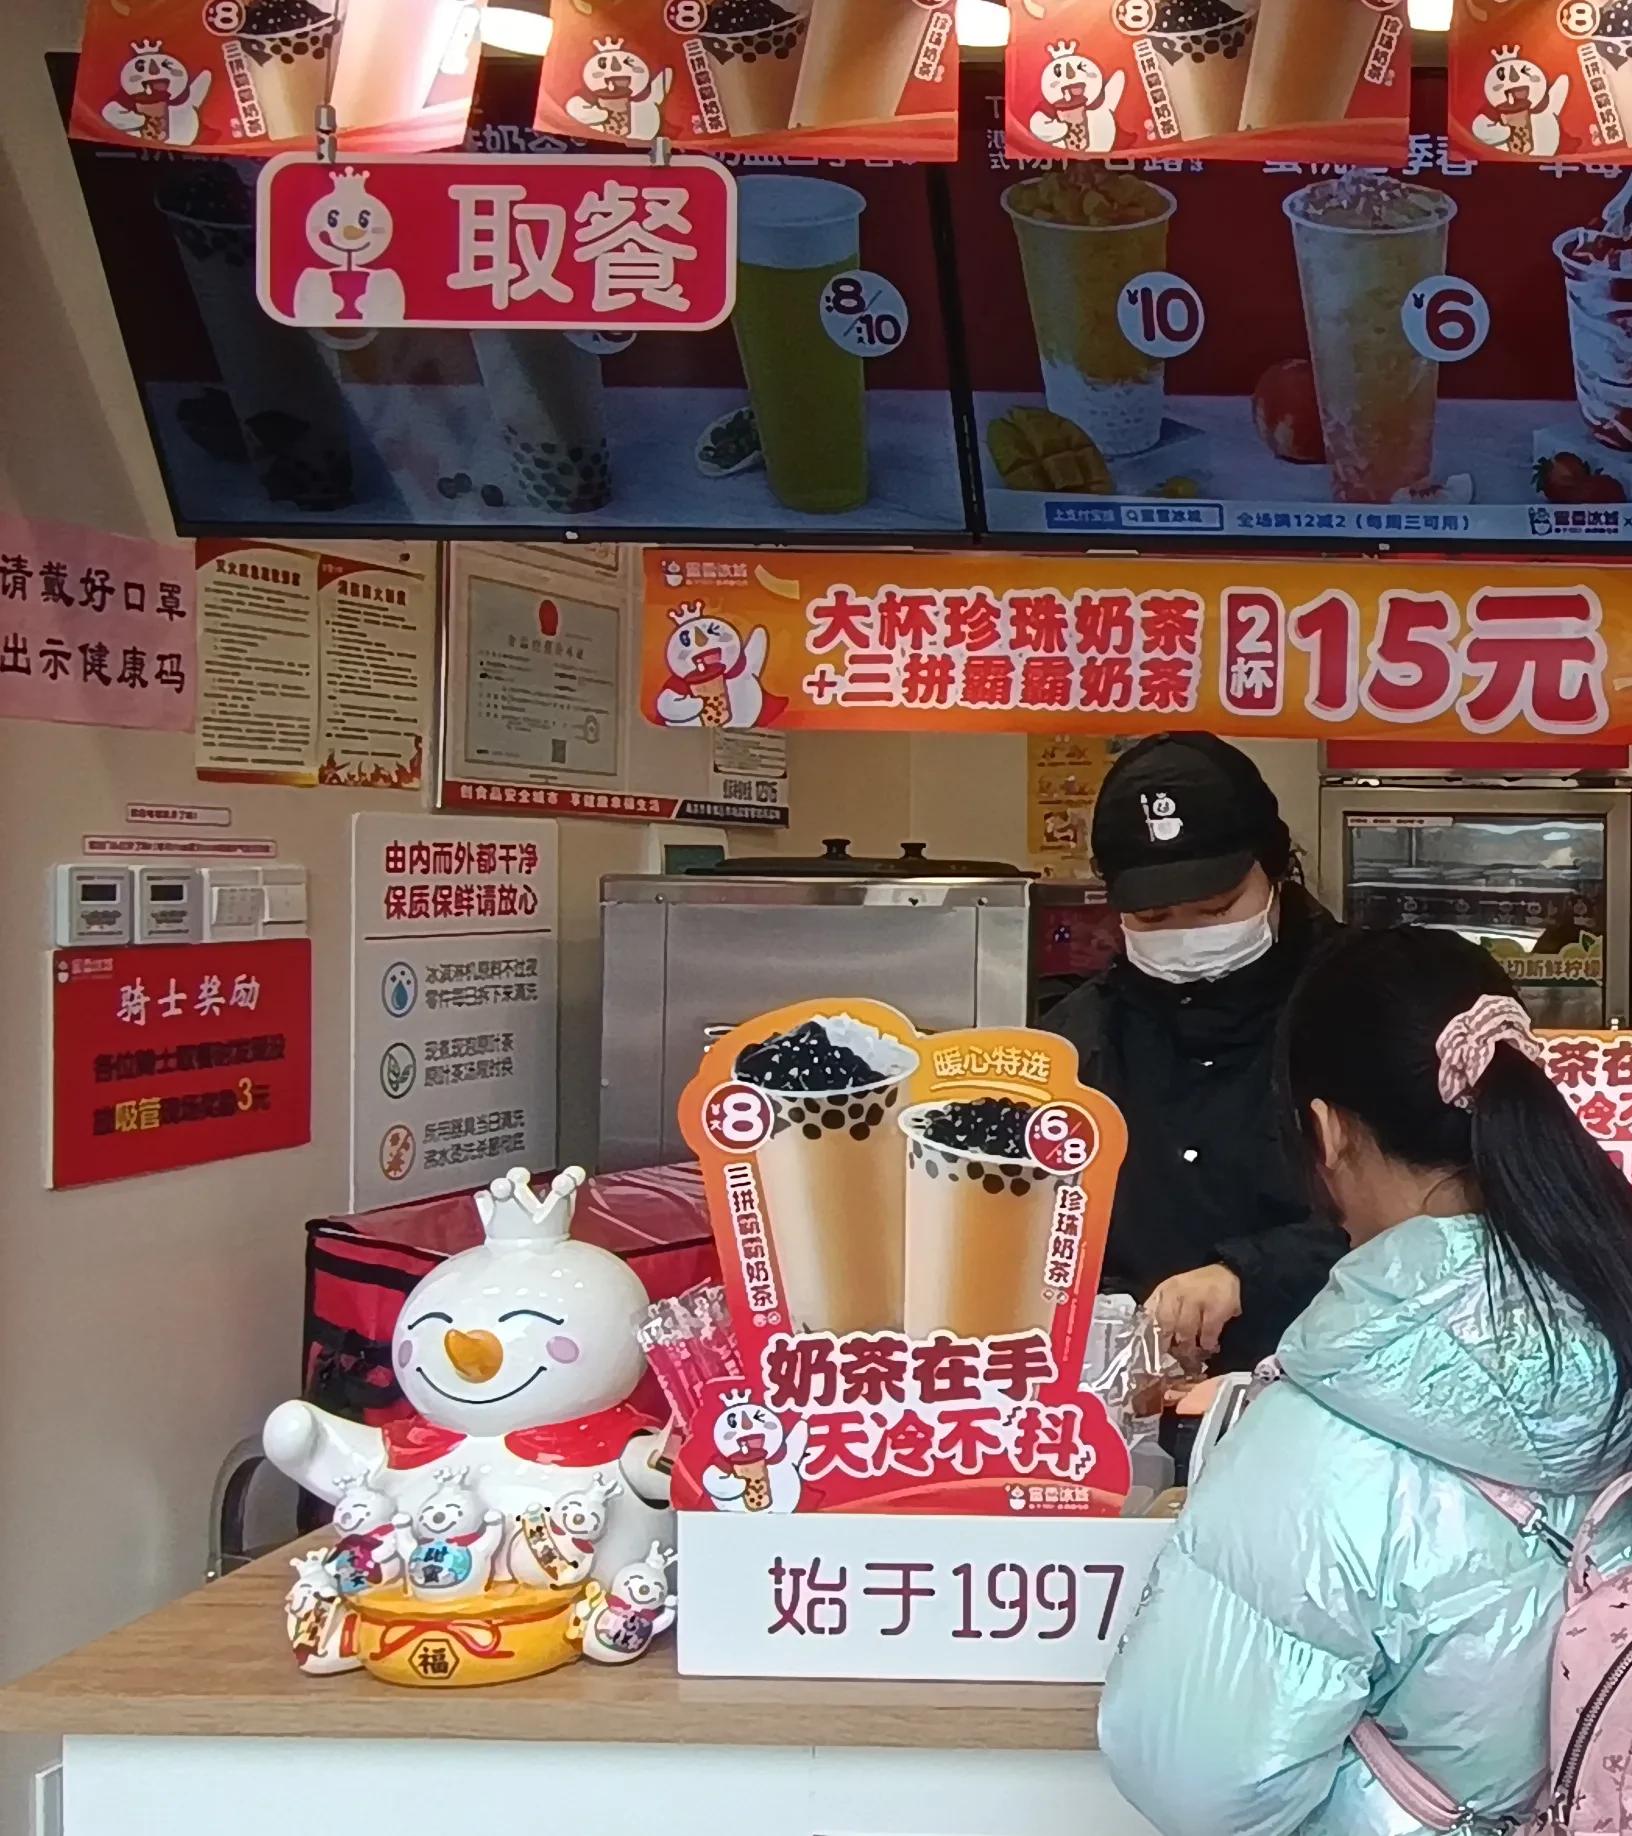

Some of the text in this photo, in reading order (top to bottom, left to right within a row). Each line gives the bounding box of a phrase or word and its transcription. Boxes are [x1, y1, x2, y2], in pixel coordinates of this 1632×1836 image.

[448, 181, 698, 312] 取餐
[0, 553, 188, 622] 请戴好口罩
[811, 589, 1199, 656] 大杯珍珠奶茶
[0, 632, 187, 695] 出示健康码
[1297, 592, 1605, 730] 15元
[384, 840, 539, 877] 由内而外都干净
[383, 883, 539, 922] 保质保鲜请放心
[116, 973, 261, 1027] 骑士奖励
[931, 1045, 1052, 1085] 暖心特选
[1045, 1188, 1085, 1286] 珍珠奶茶
[766, 1334, 1056, 1410] 奶茶在手
[803, 1406, 1086, 1475] 天冷不抖
[766, 1554, 1126, 1641] 始于1997
[418, 1646, 450, 1677] 福
